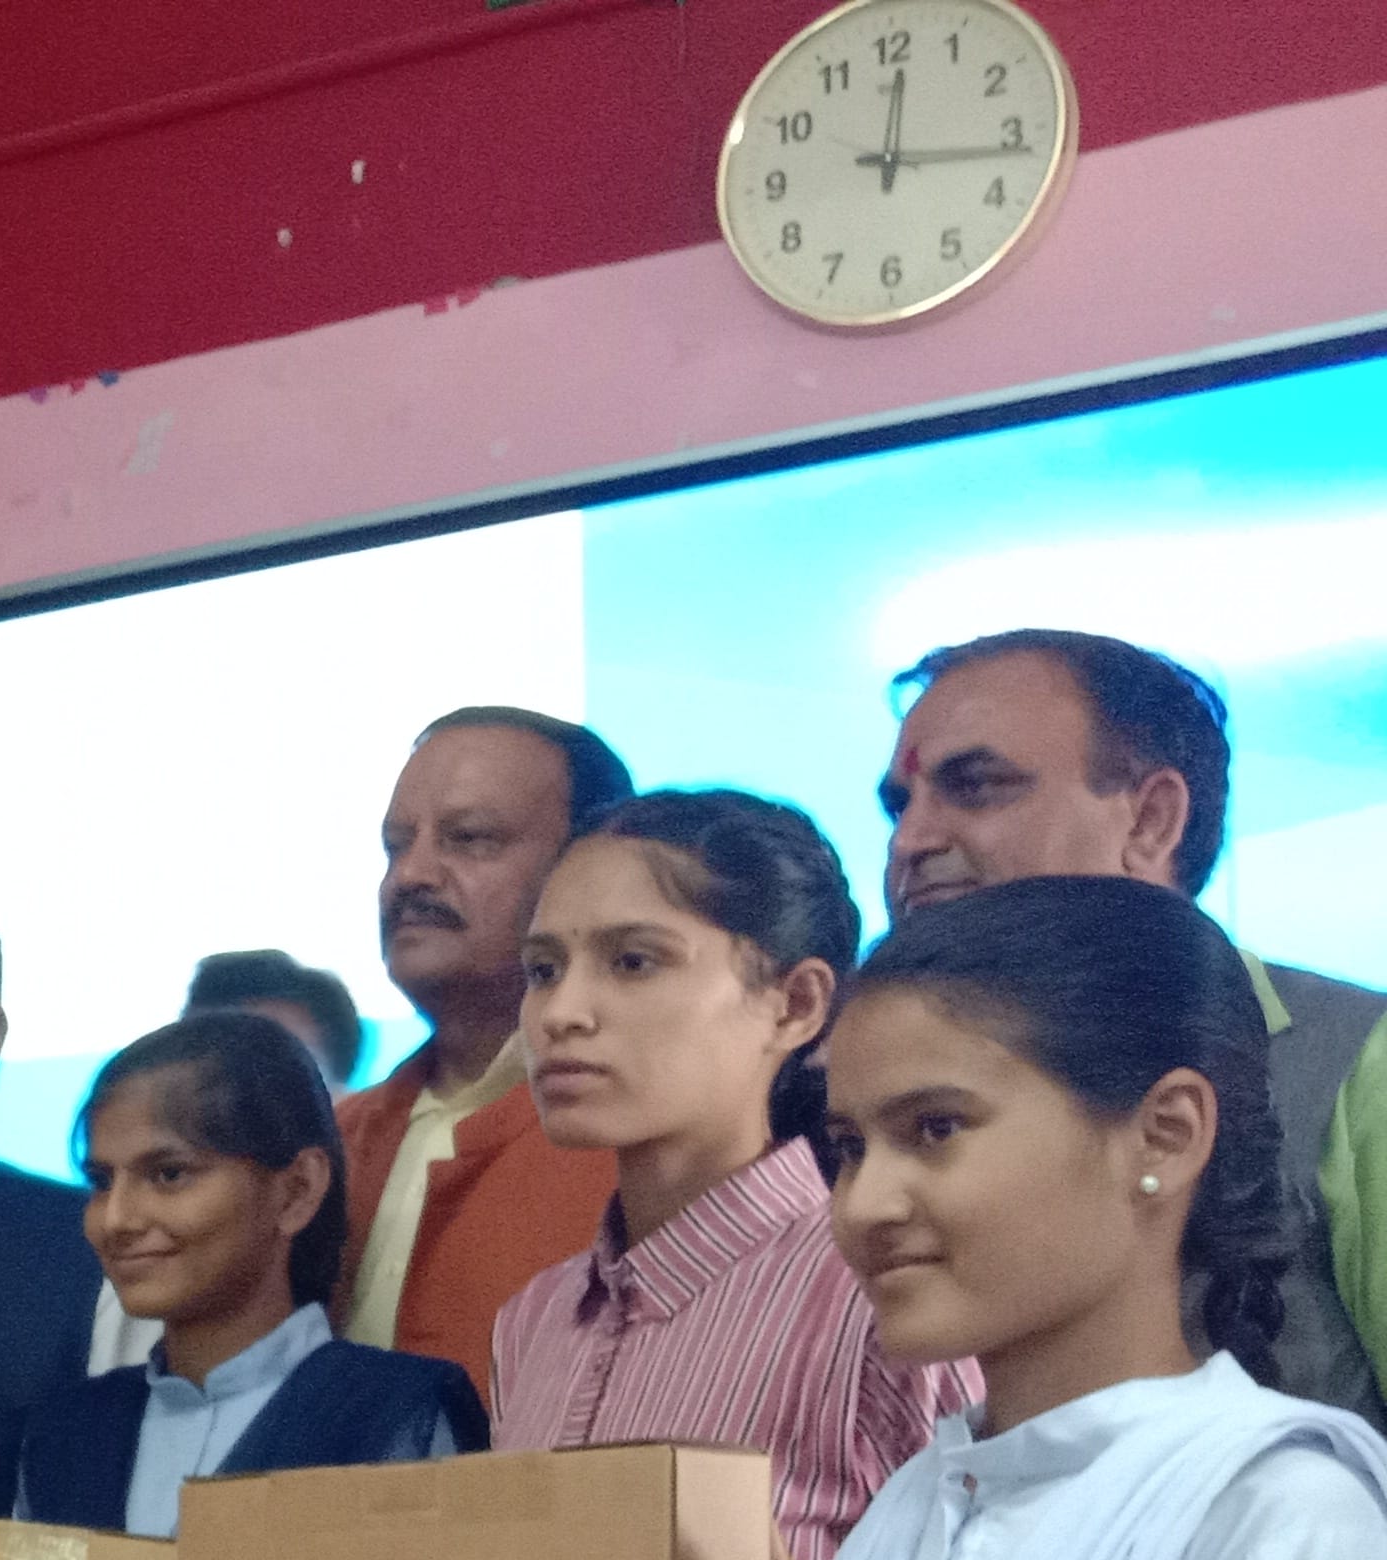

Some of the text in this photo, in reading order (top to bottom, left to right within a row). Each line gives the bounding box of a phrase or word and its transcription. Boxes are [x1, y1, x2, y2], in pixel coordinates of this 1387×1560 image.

[873, 31, 911, 65] 12
[944, 33, 959, 63] 1
[818, 61, 850, 94] 11
[984, 64, 1008, 97] 2
[776, 111, 812, 144] 10
[1001, 115, 1024, 151] 3
[765, 170, 787, 202] 9
[983, 176, 1006, 208] 4
[780, 221, 802, 253] 8
[940, 228, 962, 261] 5
[823, 253, 844, 284] 7
[880, 256, 902, 288] 6
